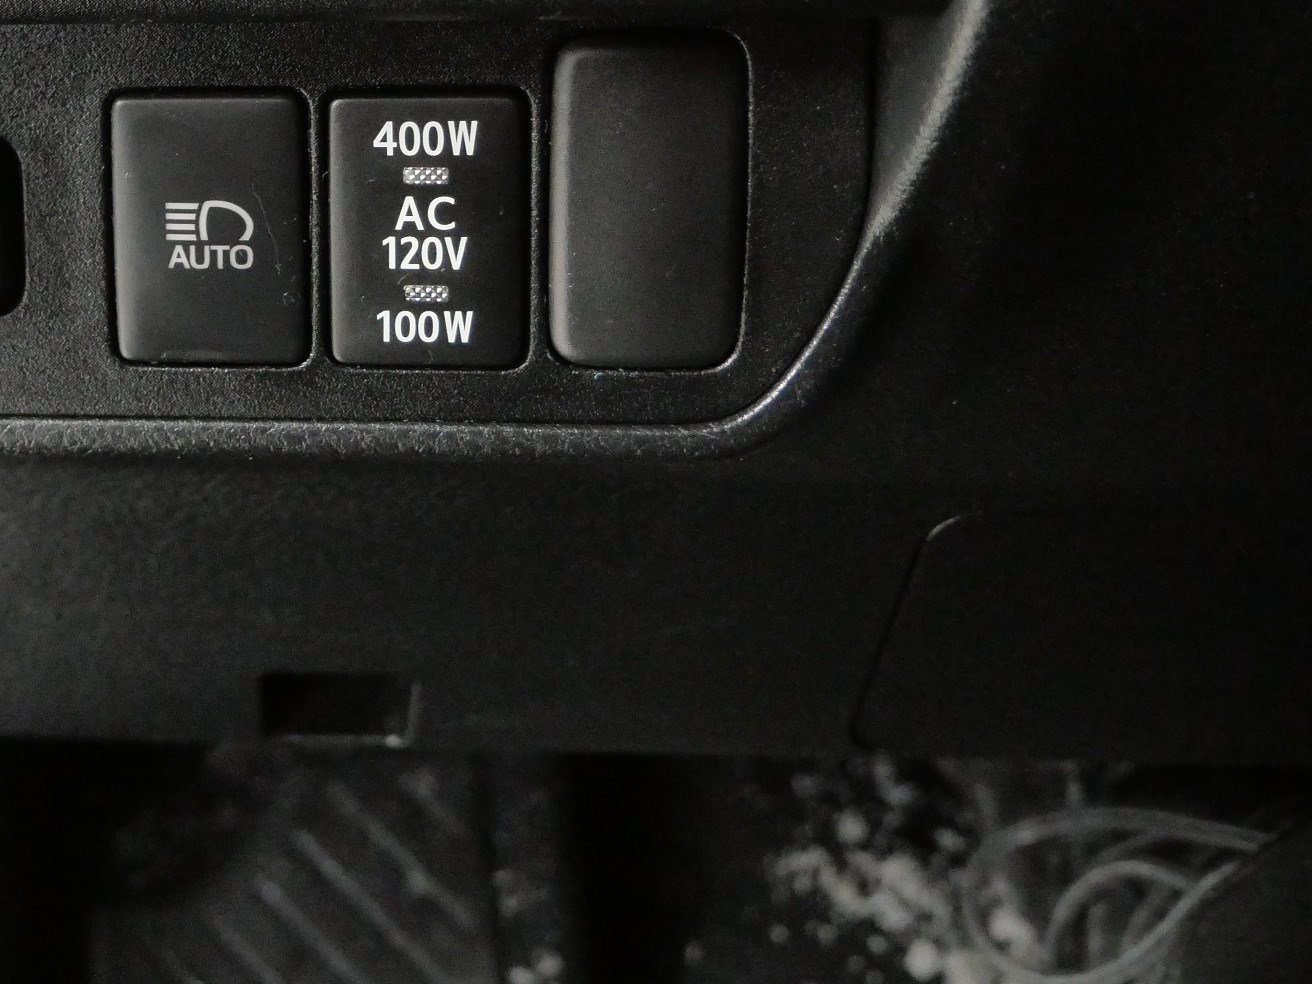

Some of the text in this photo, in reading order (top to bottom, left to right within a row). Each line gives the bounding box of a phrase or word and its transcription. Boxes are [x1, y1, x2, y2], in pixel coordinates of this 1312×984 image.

[372, 120, 479, 157] 400W
[394, 196, 457, 232] AC
[167, 244, 255, 271] AUTO
[381, 236, 468, 271] 120V
[375, 310, 474, 344] 100W
